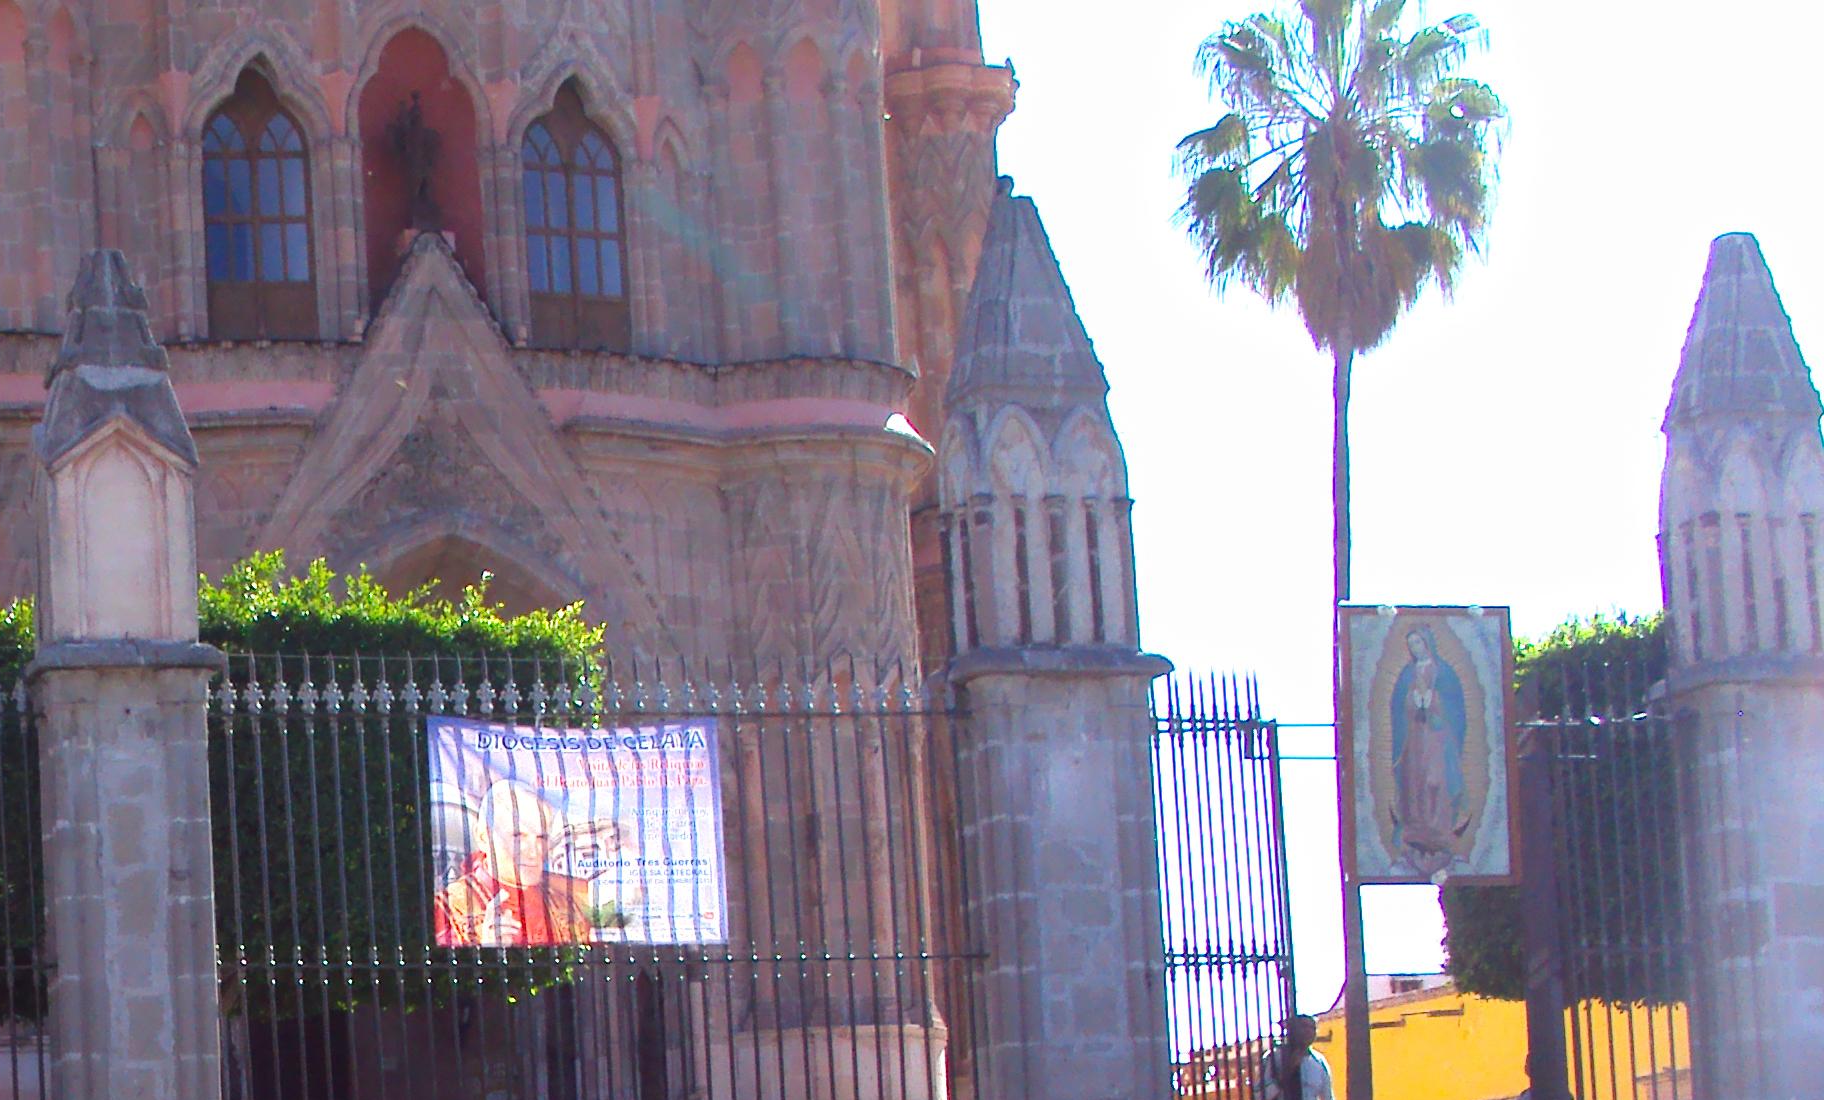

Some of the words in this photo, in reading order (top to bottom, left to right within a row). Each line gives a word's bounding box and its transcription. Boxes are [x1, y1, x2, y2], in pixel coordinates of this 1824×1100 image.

[476, 731, 581, 751] DIOCESIS
[586, 734, 615, 751] DE
[622, 729, 706, 750] CELAYA
